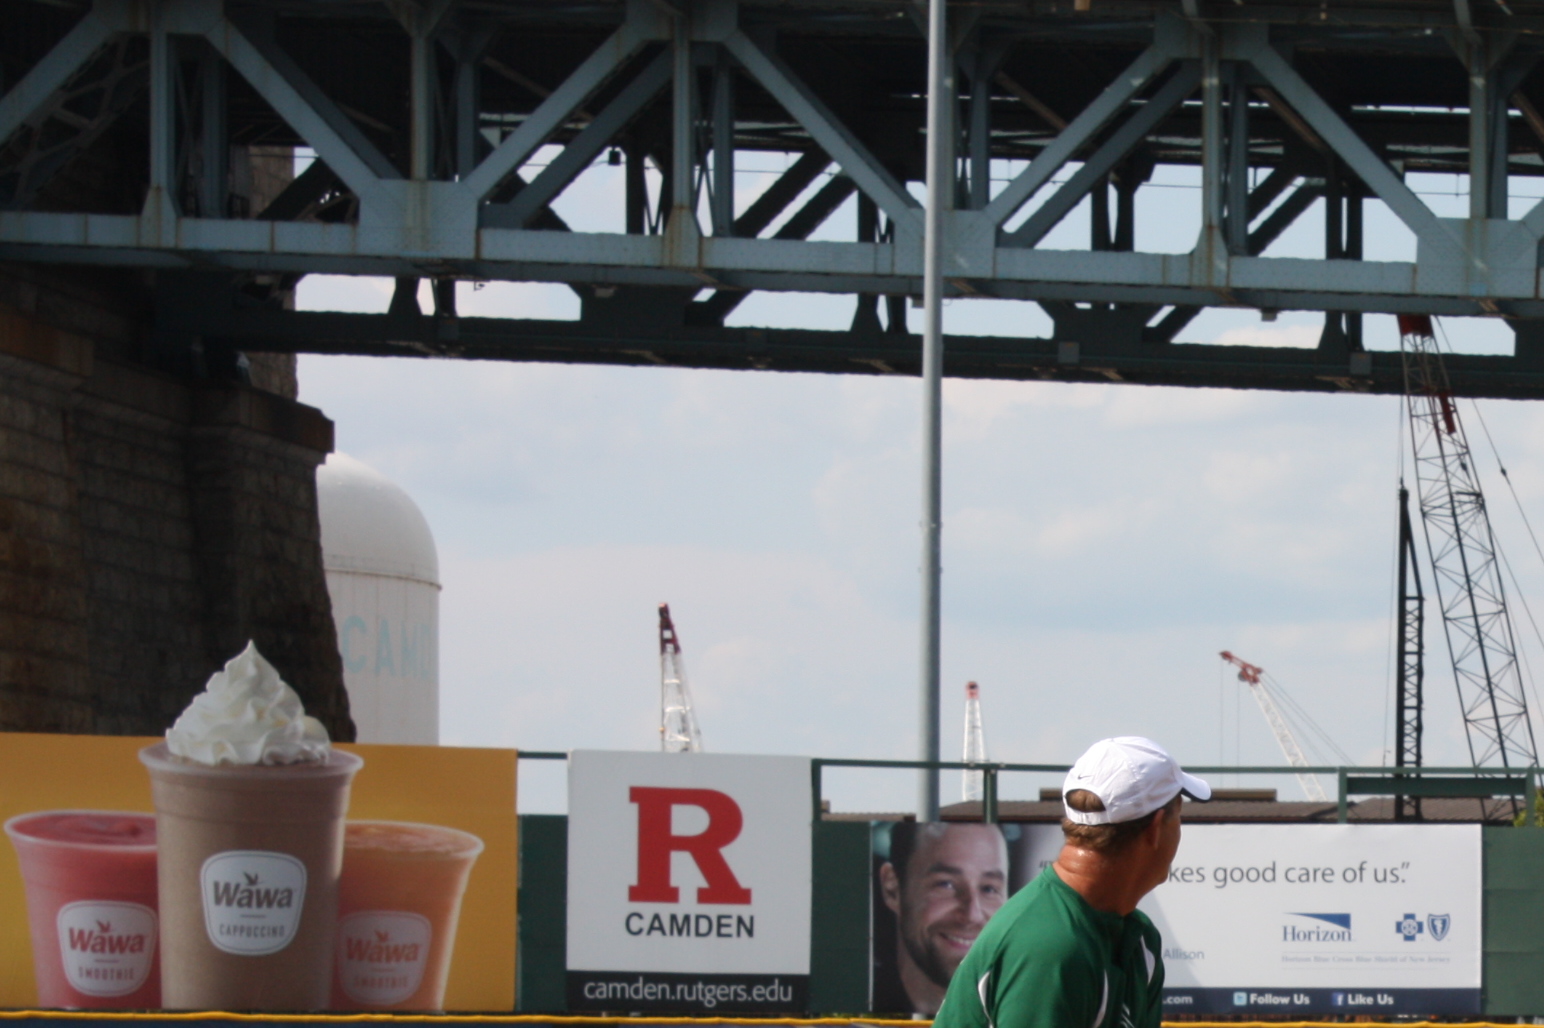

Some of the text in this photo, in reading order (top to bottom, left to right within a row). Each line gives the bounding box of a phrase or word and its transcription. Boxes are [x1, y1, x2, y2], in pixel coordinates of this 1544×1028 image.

[628, 786, 752, 905] R
[1168, 863, 1206, 883] kes
[1213, 862, 1276, 889] good
[1284, 866, 1337, 884] care
[1342, 862, 1370, 884] of
[212, 880, 293, 909] Wawa
[218, 924, 285, 938] CAPPUCCINO
[625, 912, 755, 939] CAMDEN
[1282, 925, 1352, 942] Horizon
[68, 927, 146, 954] Wawa
[345, 937, 419, 963] Wawa
[1163, 948, 1205, 960] Allison
[78, 966, 135, 981] SMOOTHIE
[352, 975, 409, 989] SMOOTHIE
[584, 978, 792, 1007] camden.rutgers.edu
[1162, 995, 1193, 1005] .com
[1250, 994, 1311, 1005] Follow Us
[1347, 993, 1374, 1005] Like
[1377, 993, 1394, 1005] Us
